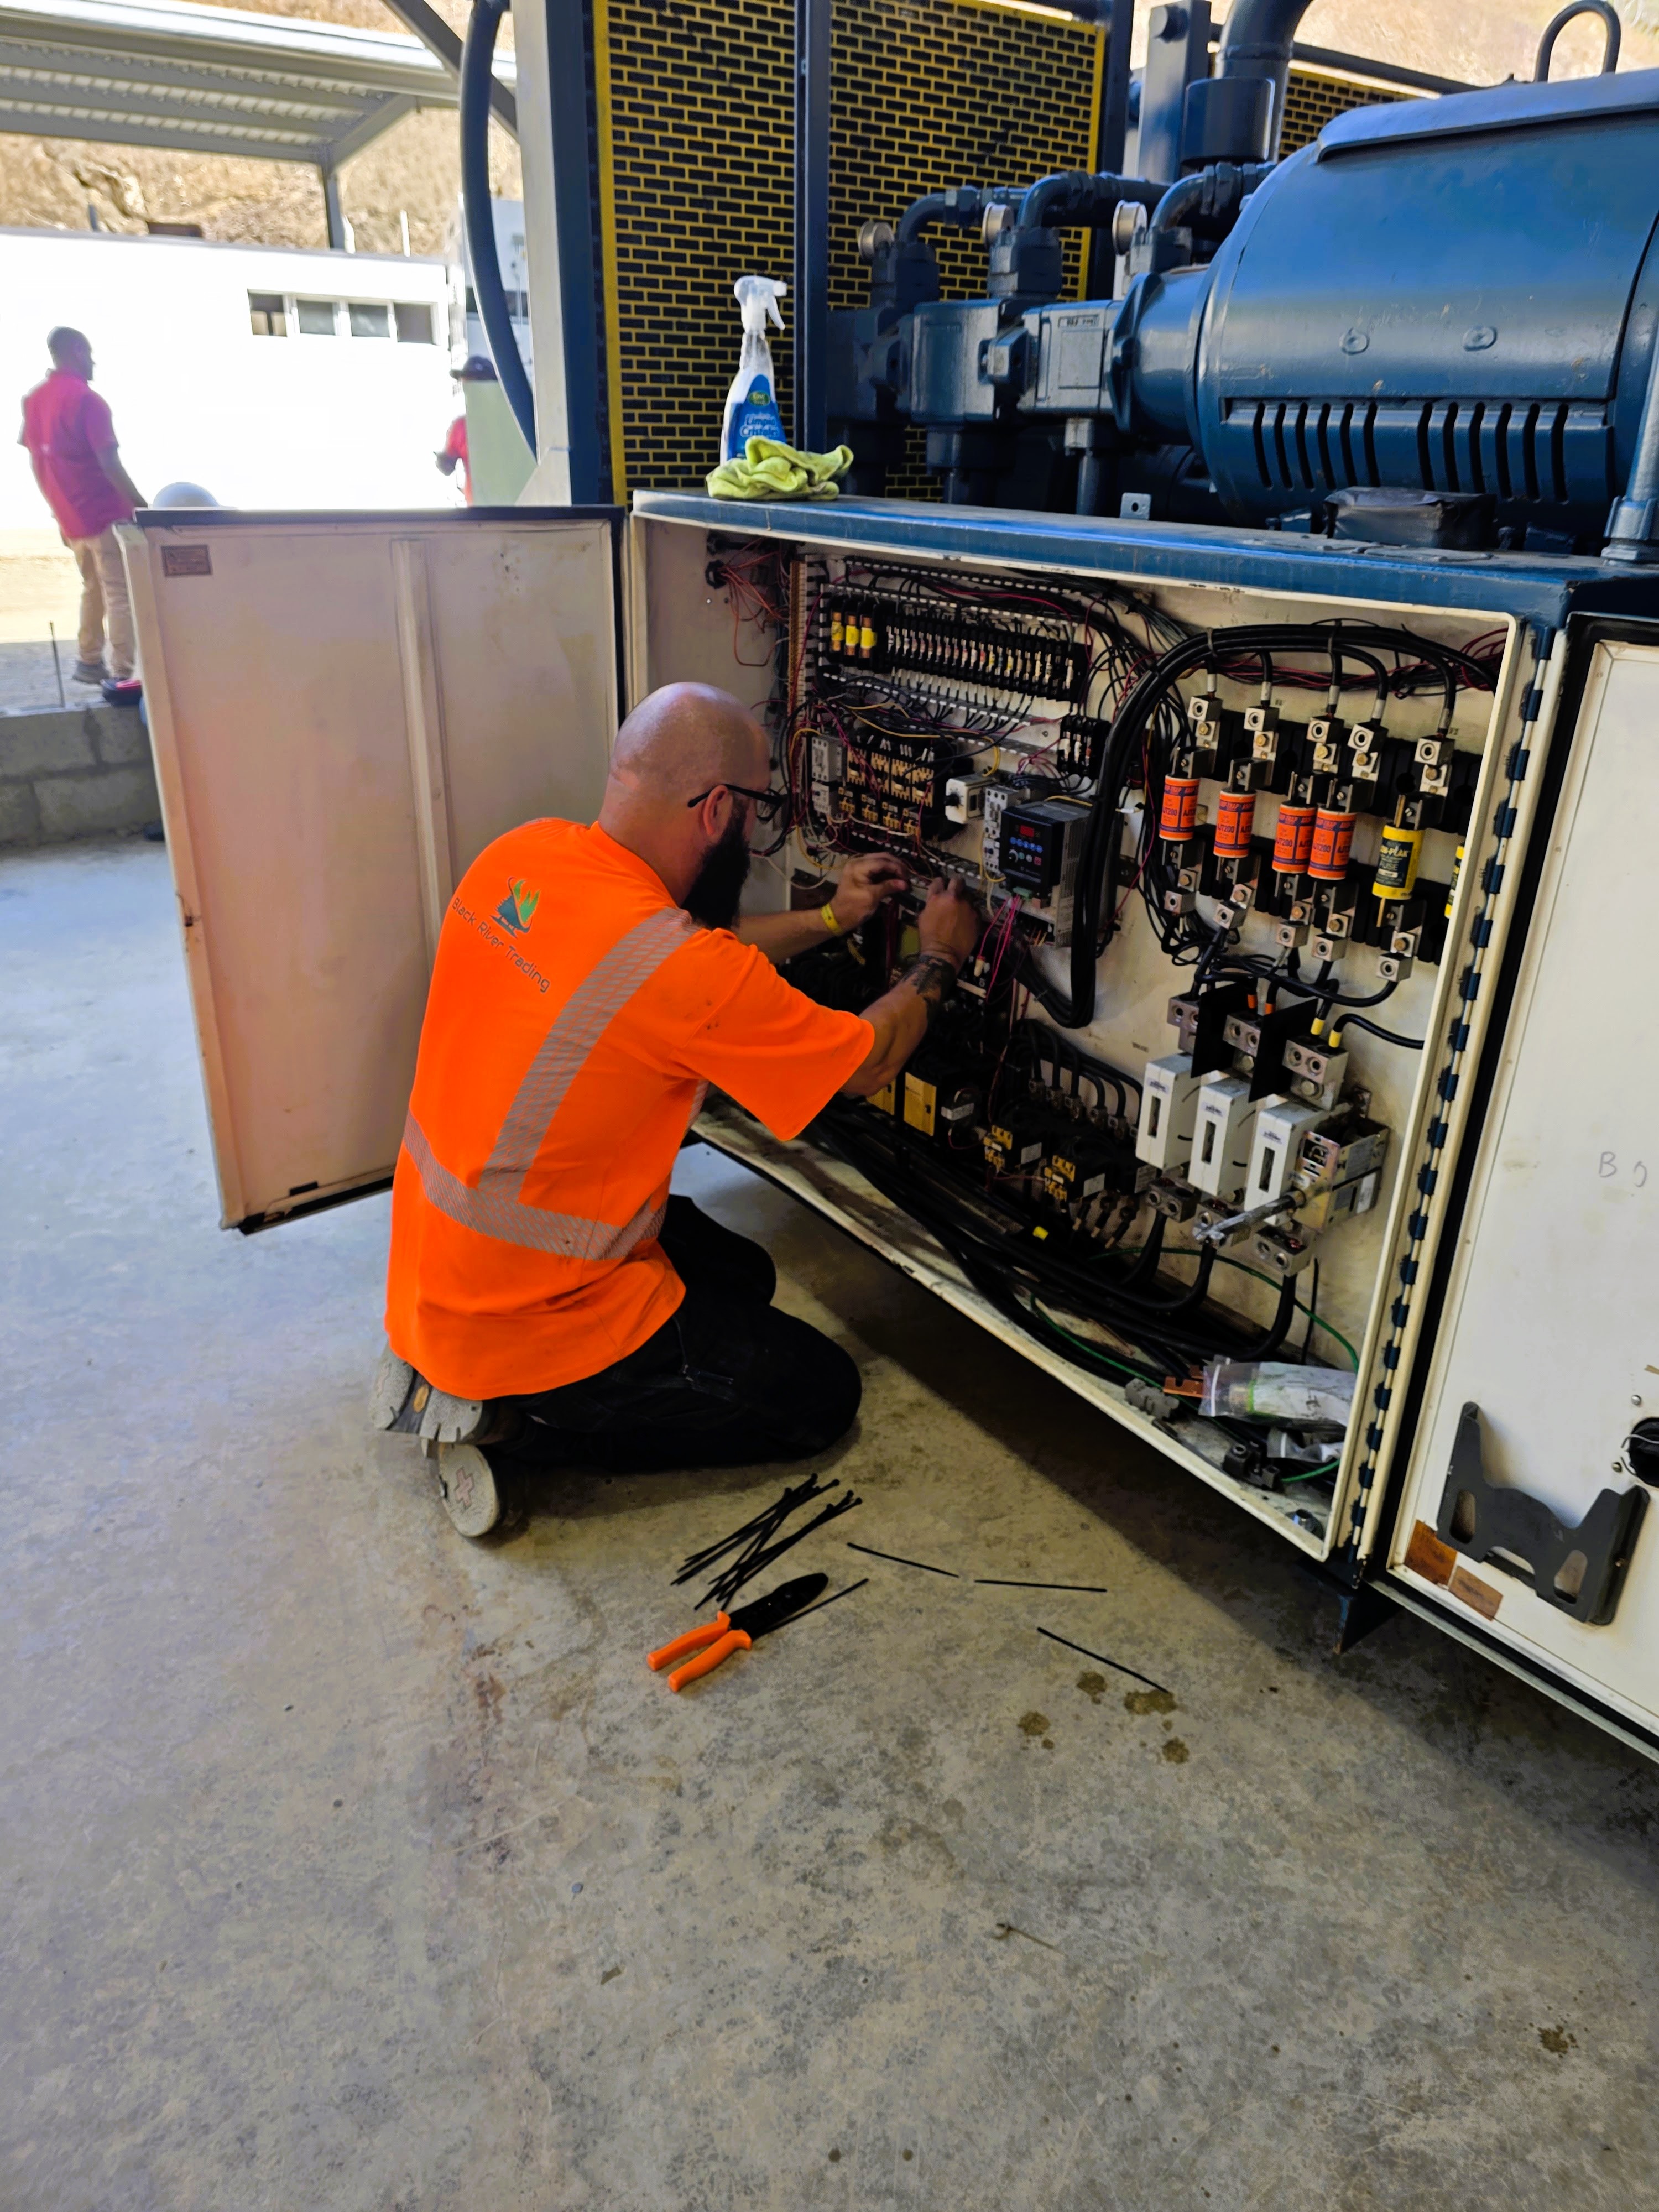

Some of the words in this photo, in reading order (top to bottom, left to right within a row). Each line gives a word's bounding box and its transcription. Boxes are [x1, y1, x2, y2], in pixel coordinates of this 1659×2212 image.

[452, 897, 477, 926] Black
[476, 921, 504, 949] River
[505, 945, 550, 993] Trading
